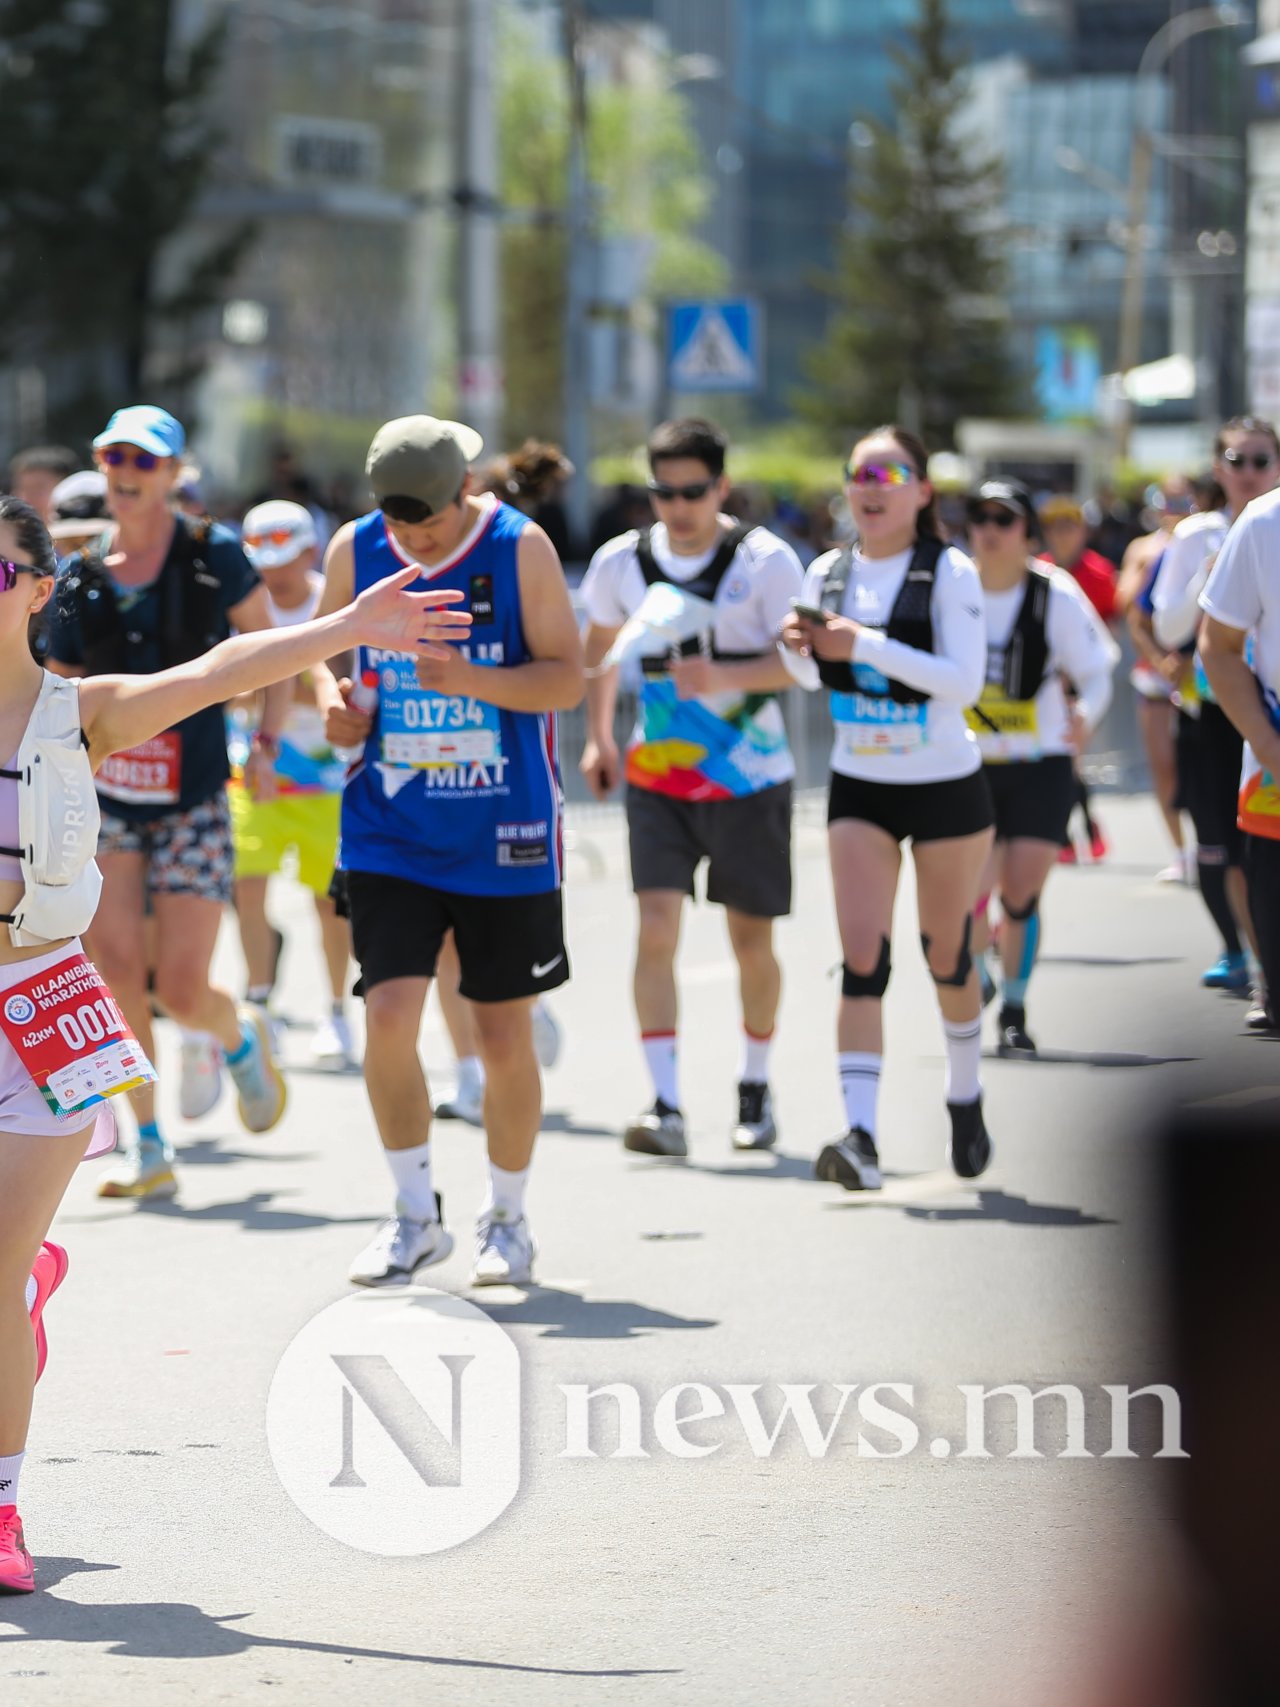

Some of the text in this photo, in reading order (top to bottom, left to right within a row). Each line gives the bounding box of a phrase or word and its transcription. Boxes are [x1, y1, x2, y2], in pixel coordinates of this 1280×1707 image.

[404, 697, 485, 728] 01734
[425, 757, 509, 789] MIAT
[22, 1025, 56, 1048] 42KM
